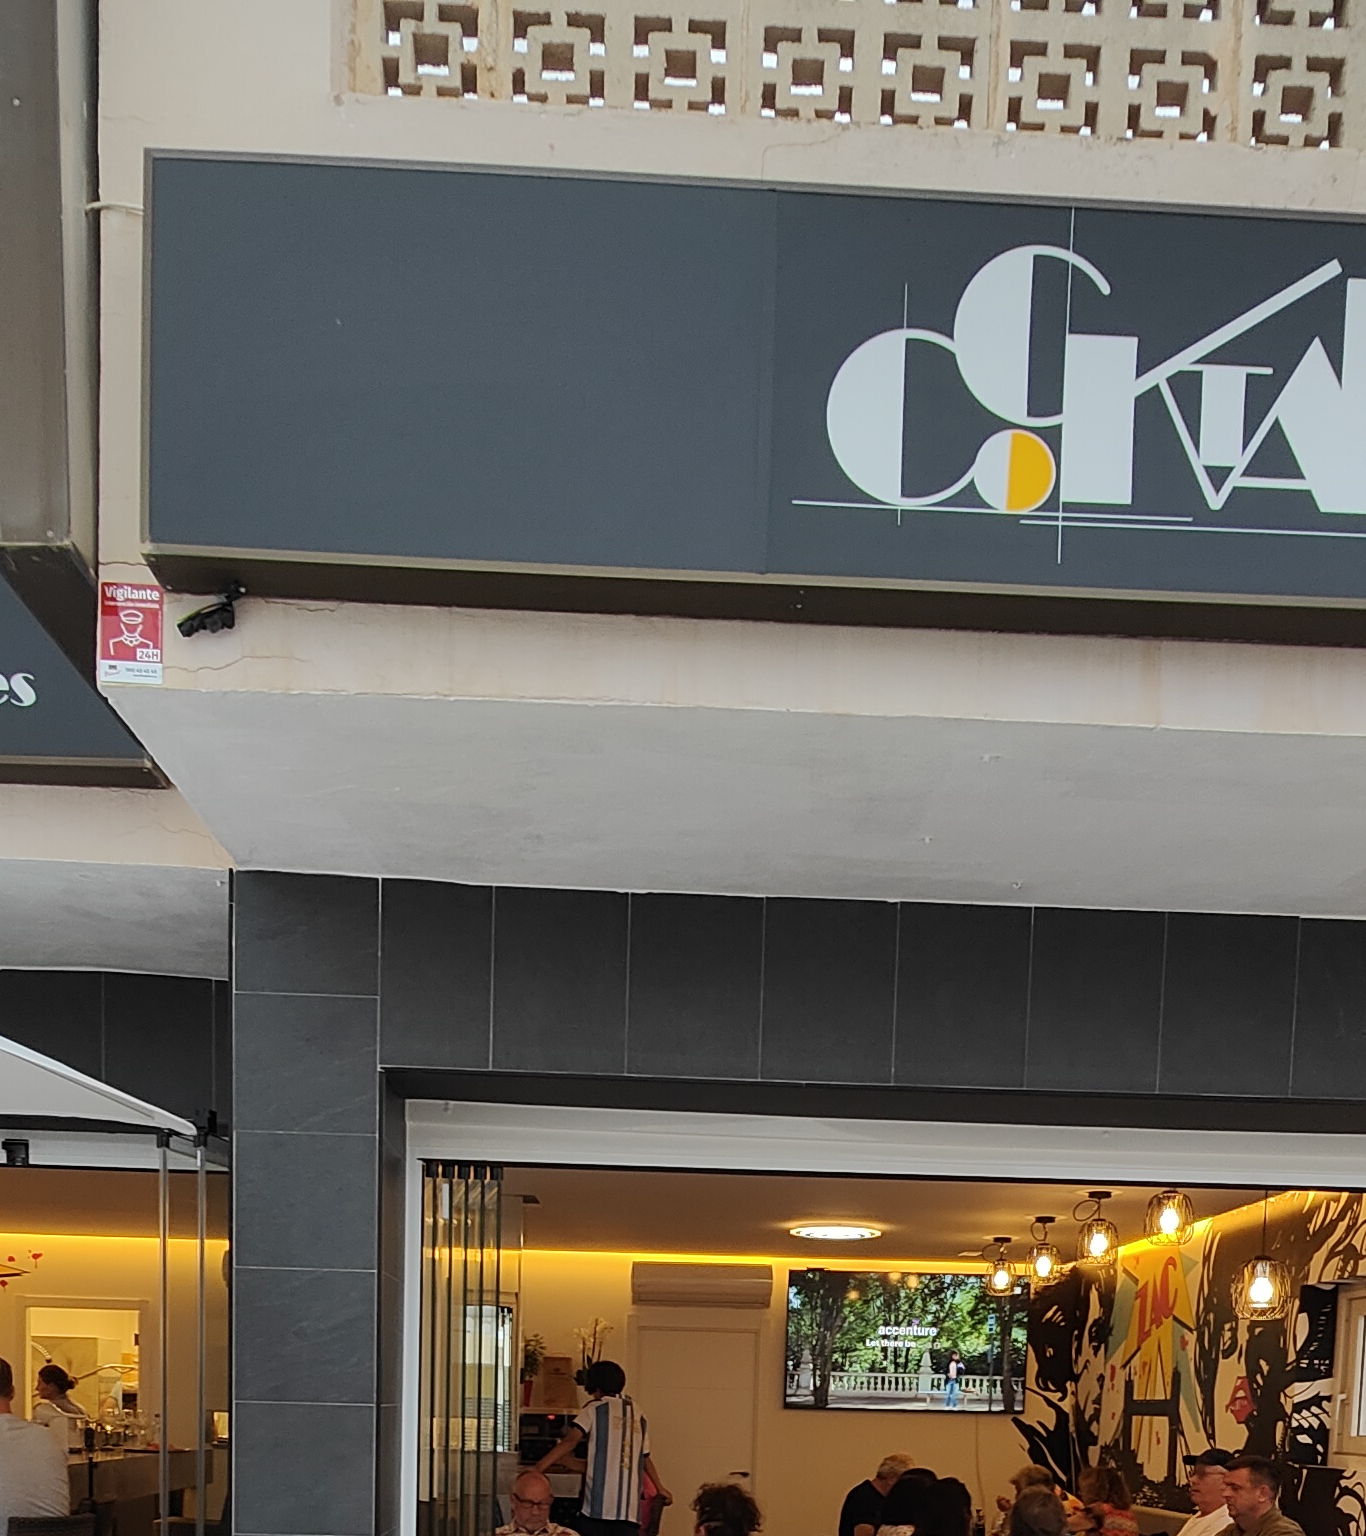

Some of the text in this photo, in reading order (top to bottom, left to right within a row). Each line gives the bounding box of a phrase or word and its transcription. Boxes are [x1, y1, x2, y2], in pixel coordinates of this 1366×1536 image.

[104, 585, 160, 601] Vigilante
[138, 650, 159, 660] 24H
[878, 1325, 938, 1336] accenture
